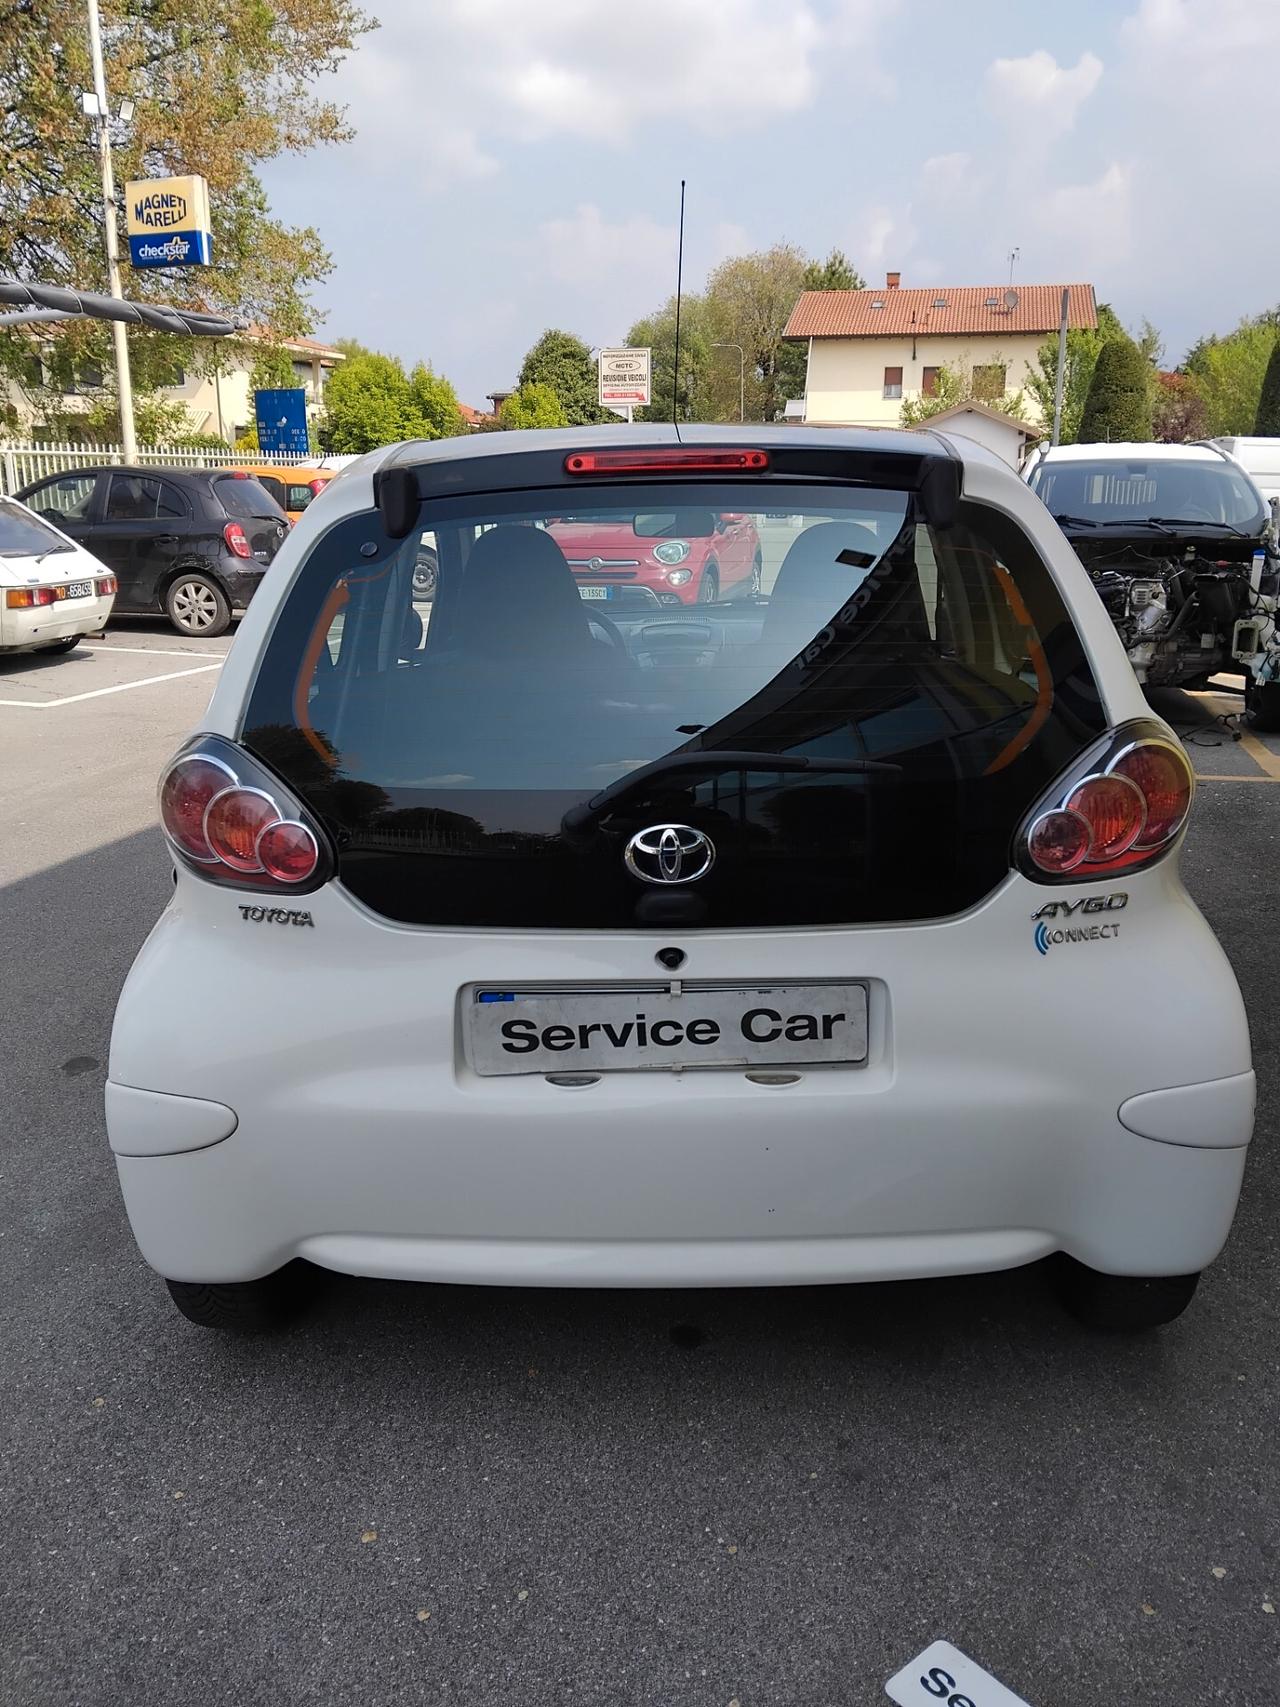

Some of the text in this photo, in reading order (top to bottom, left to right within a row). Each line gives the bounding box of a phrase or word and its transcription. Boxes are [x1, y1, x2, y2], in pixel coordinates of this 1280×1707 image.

[135, 193, 187, 213] MAGNETI
[135, 207, 187, 227] MARELLI
[139, 243, 190, 258] checkstar
[238, 904, 315, 928] TOYOTA
[1030, 891, 1129, 920] AYGO
[501, 1008, 847, 1054] Service Car
